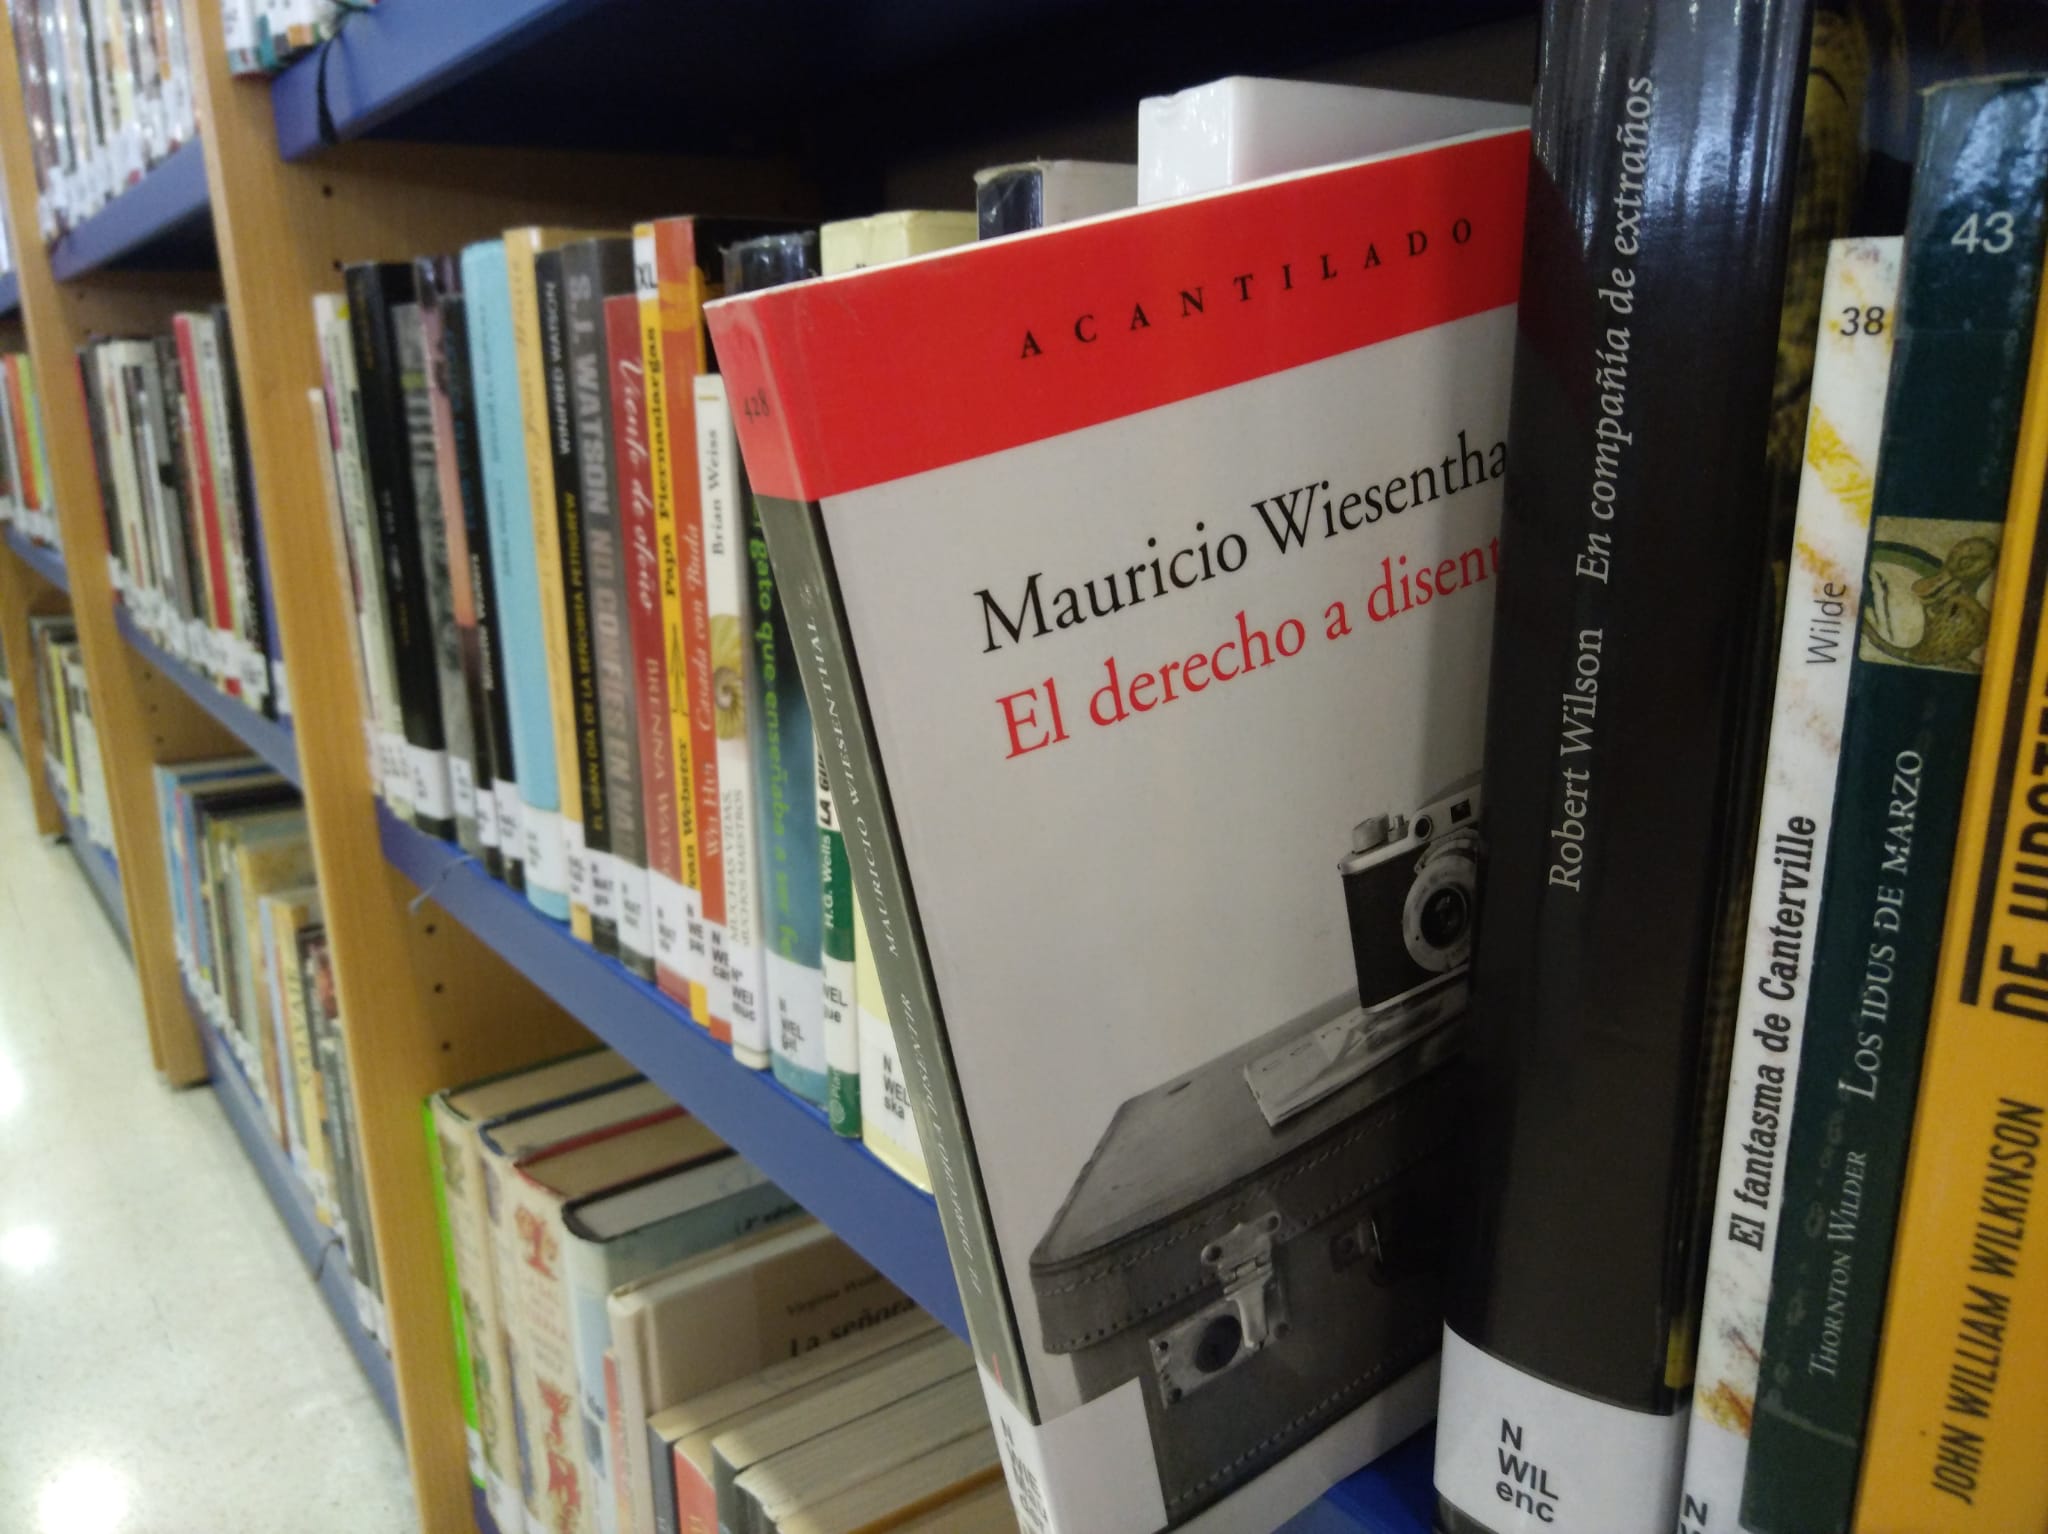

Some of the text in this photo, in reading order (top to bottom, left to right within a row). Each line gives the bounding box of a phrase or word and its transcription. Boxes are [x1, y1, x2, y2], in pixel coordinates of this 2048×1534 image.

[1950, 211, 2016, 254] 43
[637, 264, 658, 289] XL
[1020, 218, 1472, 359] ACANTILADO
[1839, 306, 1886, 337] 38
[575, 352, 610, 515] WATSON
[707, 429, 725, 556] Brian Weiss
[1548, 76, 1654, 892] Robert Wilson En compañía de extraños
[974, 521, 1248, 653] Mauricio
[1805, 580, 1847, 666] Wilde
[755, 621, 777, 682] que
[996, 678, 1070, 760] El
[1088, 610, 1306, 727] derecho
[1325, 601, 1353, 640] a
[1881, 749, 1924, 877] MARZO
[821, 835, 833, 883] Wells
[1873, 884, 1905, 933] DE
[1860, 942, 1896, 1024] IDUS
[1728, 815, 1817, 1252] El fantasma de Canterville
[1808, 1150, 1868, 1378] THORNTON WILDER
[1931, 1097, 2046, 1505] JOHN WILLIAM WILKINSON
[1497, 1447, 1559, 1501] WIL
[1501, 1417, 1523, 1451] N
[1495, 1480, 1555, 1523] enc
[1684, 1492, 1708, 1527] N
